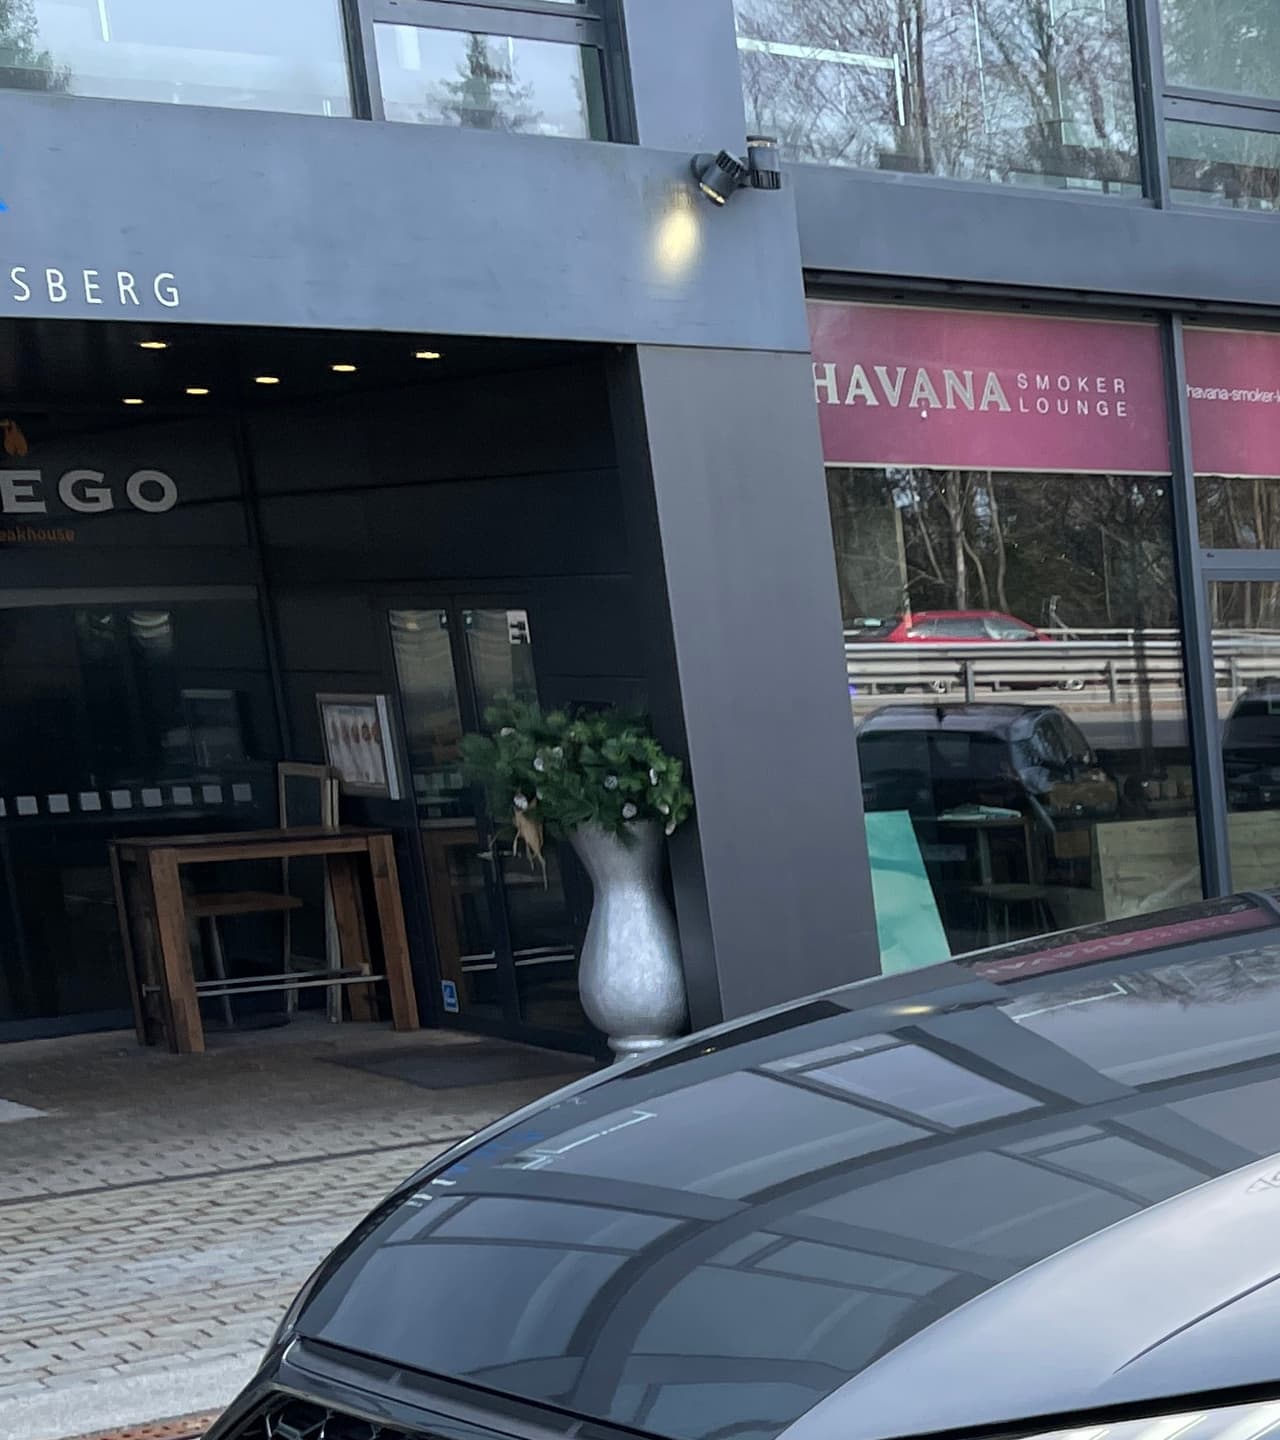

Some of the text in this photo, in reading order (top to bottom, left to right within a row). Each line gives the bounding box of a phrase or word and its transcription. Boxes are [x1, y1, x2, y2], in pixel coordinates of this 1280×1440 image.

[10, 266, 180, 307] SBERG
[812, 362, 1012, 413] HAVANA
[1016, 373, 1126, 394] SMOKER
[1018, 395, 1128, 417] LOUNGE
[0, 469, 178, 513] EGO
